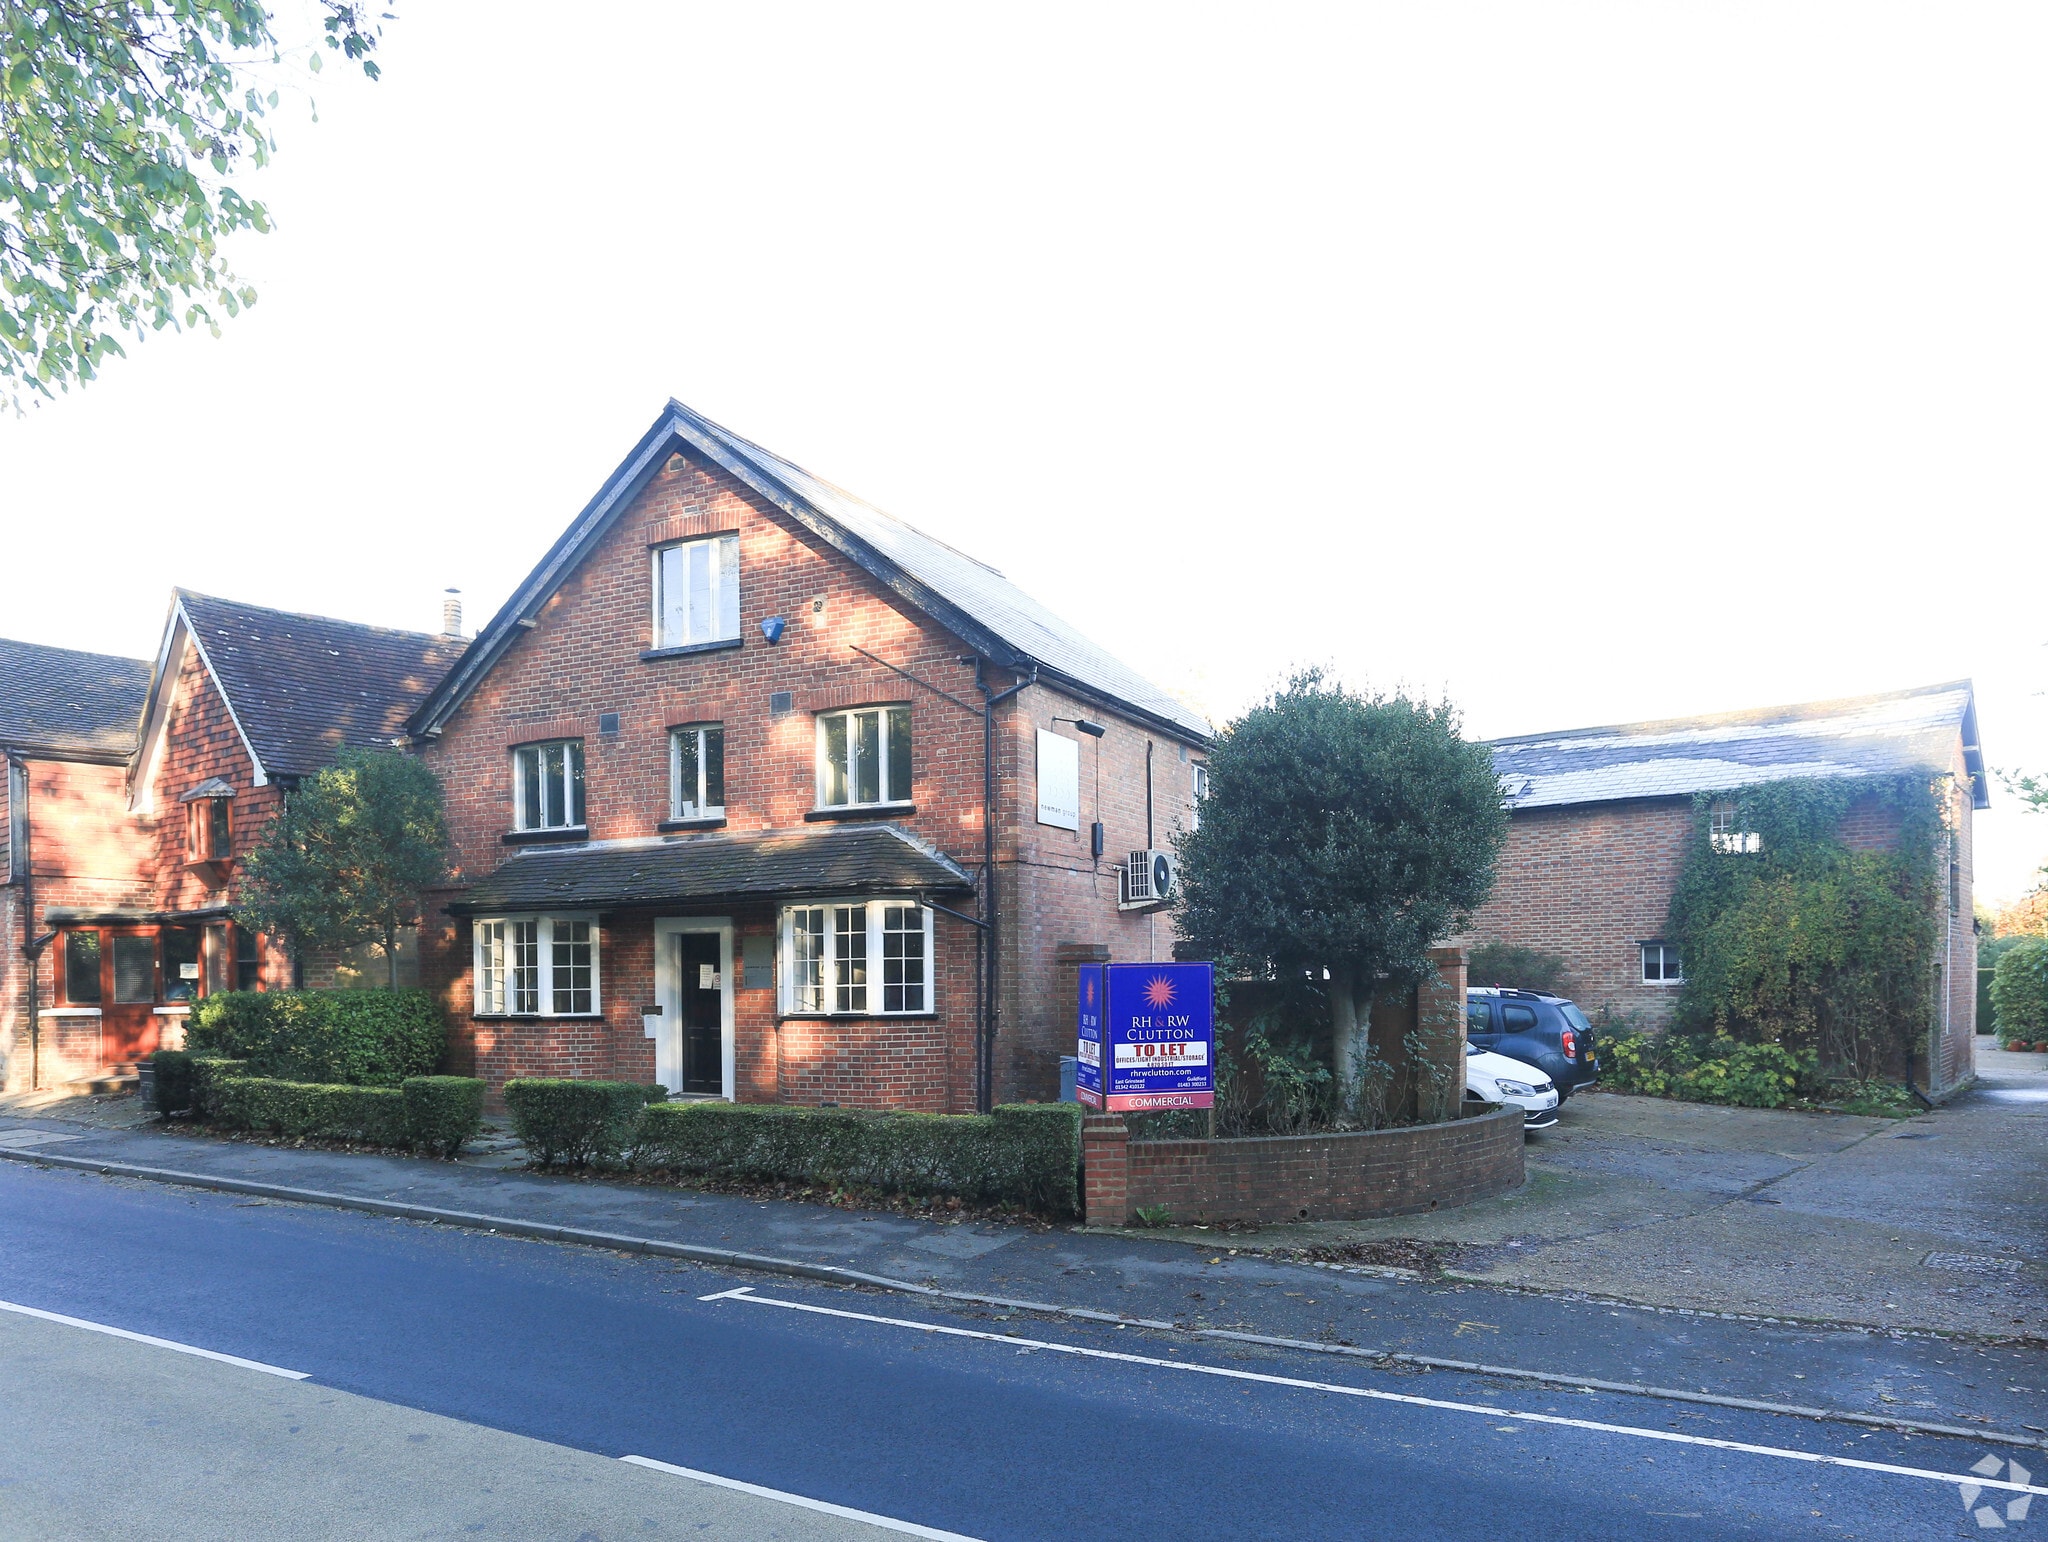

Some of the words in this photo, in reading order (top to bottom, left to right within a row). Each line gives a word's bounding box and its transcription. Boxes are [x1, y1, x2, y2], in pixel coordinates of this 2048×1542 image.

[1132, 1016, 1152, 1028] RH
[1155, 1016, 1165, 1027] &
[1167, 1015, 1190, 1027] RW
[1126, 1029, 1194, 1041] CLUTTON
[1133, 1044, 1155, 1057] TO
[1160, 1043, 1187, 1056] LET
[1130, 1069, 1192, 1077] rhrwclutton.com
[1129, 1097, 1194, 1107] COMMERCIAL
